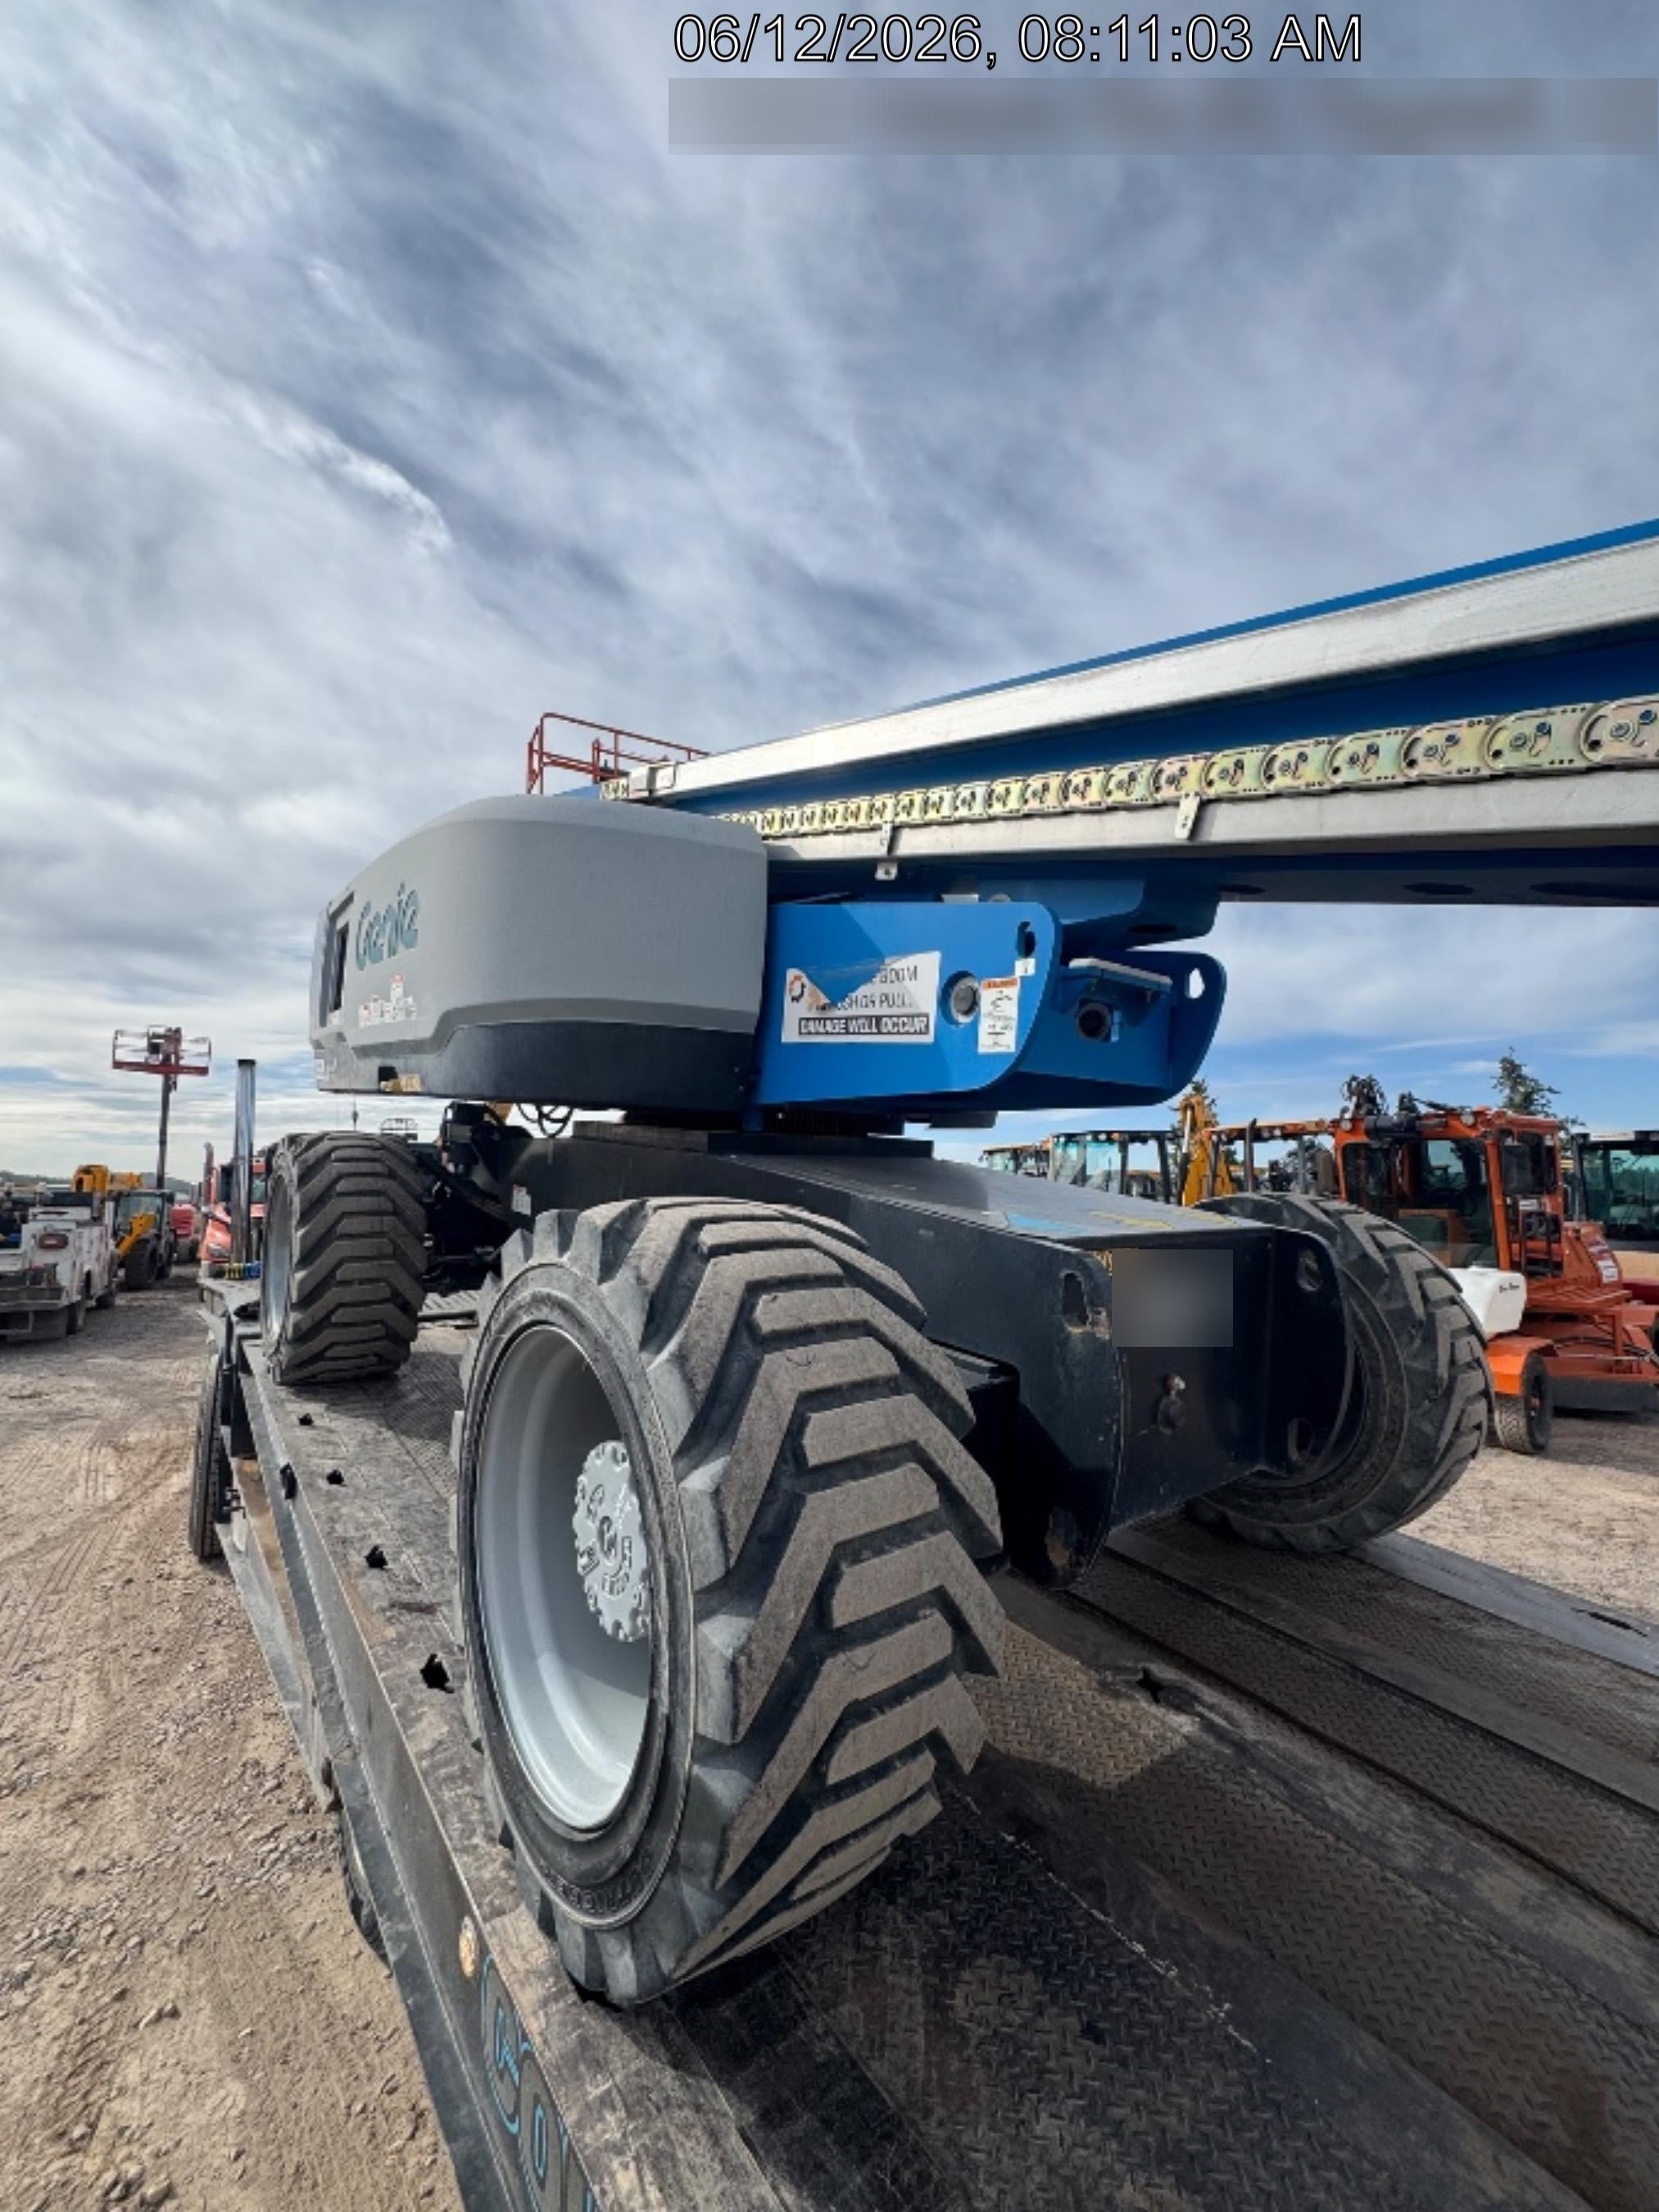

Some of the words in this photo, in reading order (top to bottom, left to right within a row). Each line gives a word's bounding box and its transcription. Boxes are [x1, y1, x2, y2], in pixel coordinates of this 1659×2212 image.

[356, 880, 419, 971] Genie
[800, 1019, 846, 1033] DAMAGE
[847, 1018, 879, 1033] WILL
[881, 1016, 927, 1033] OCCUR
